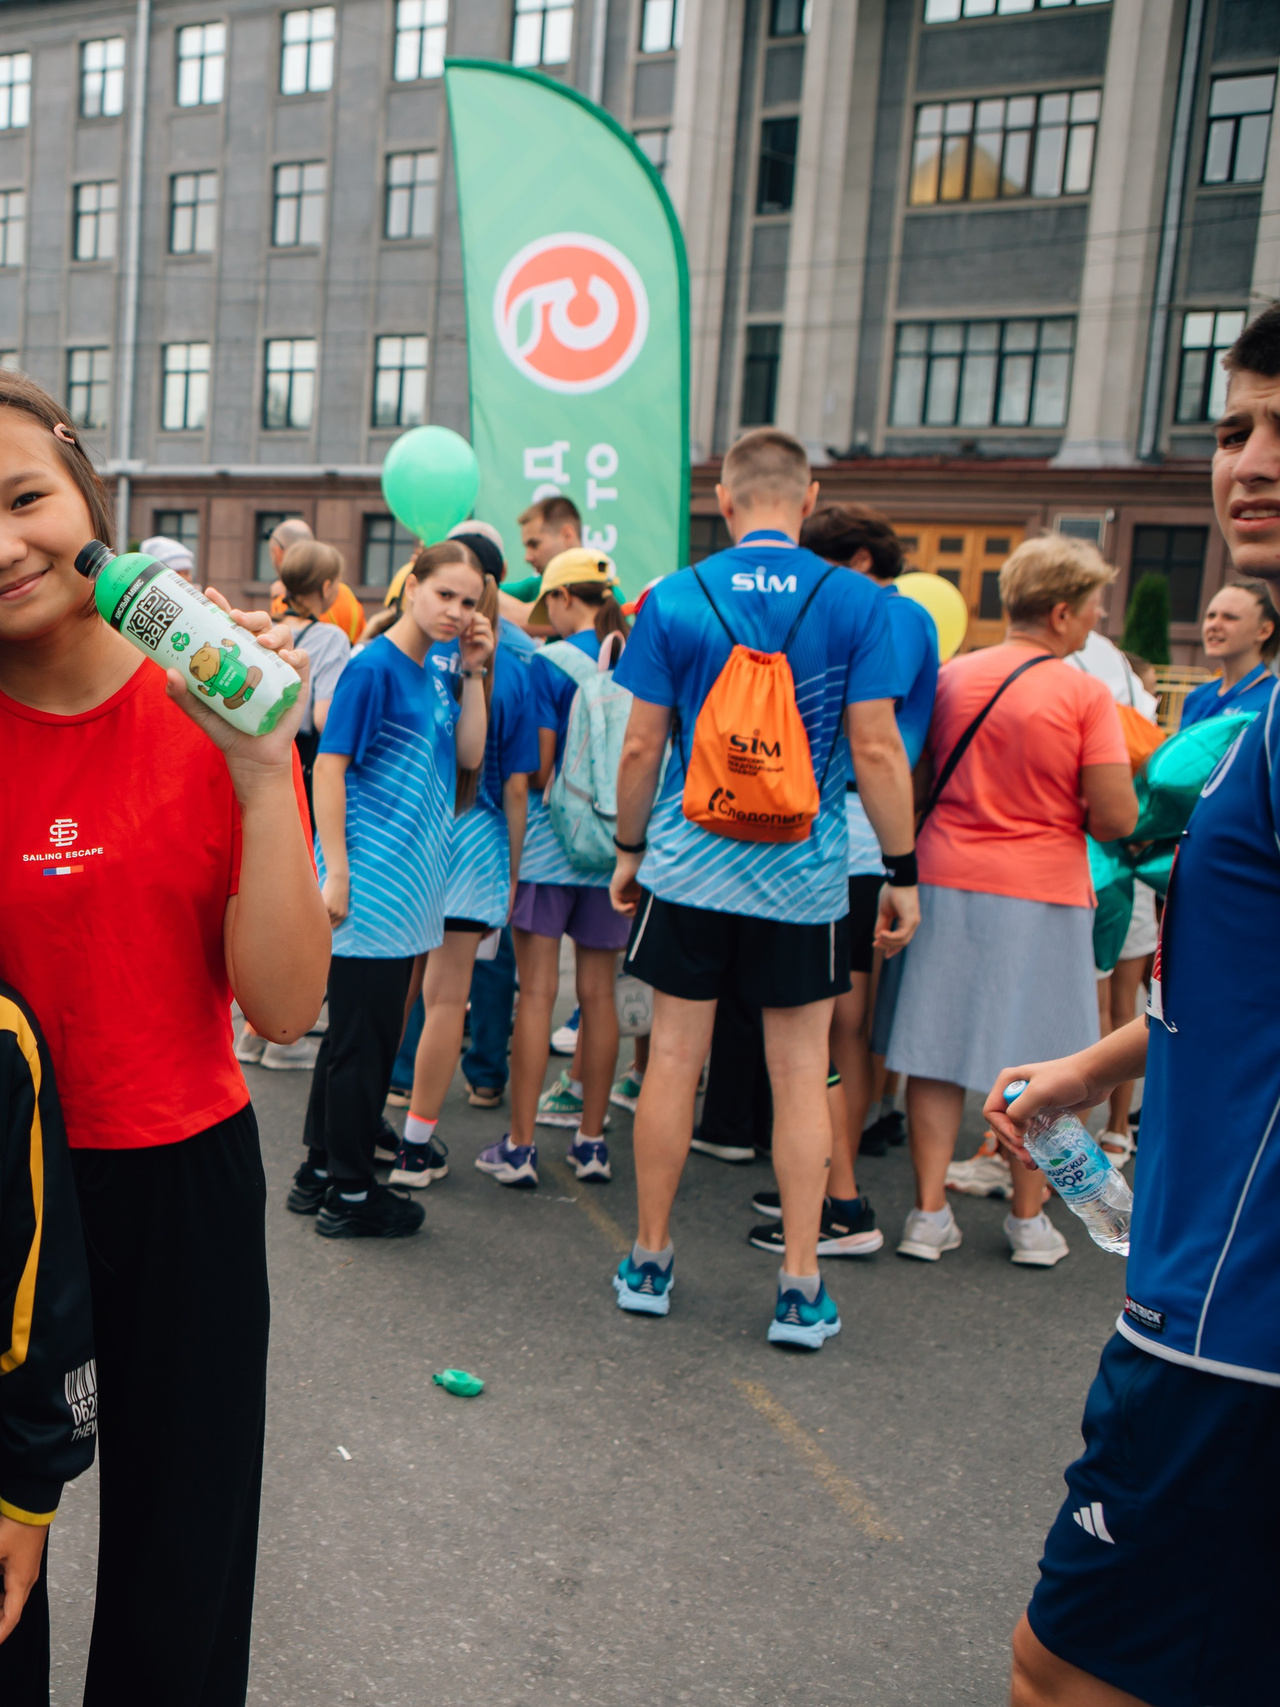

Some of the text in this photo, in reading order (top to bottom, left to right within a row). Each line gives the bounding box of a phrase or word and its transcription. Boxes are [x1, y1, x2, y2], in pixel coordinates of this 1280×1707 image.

[115, 594, 131, 620] КИСЛЫЙ
[128, 579, 144, 597] МИКС
[23, 847, 104, 862] SAILING ESCAPE
[1054, 1170, 1084, 1187] БОР
